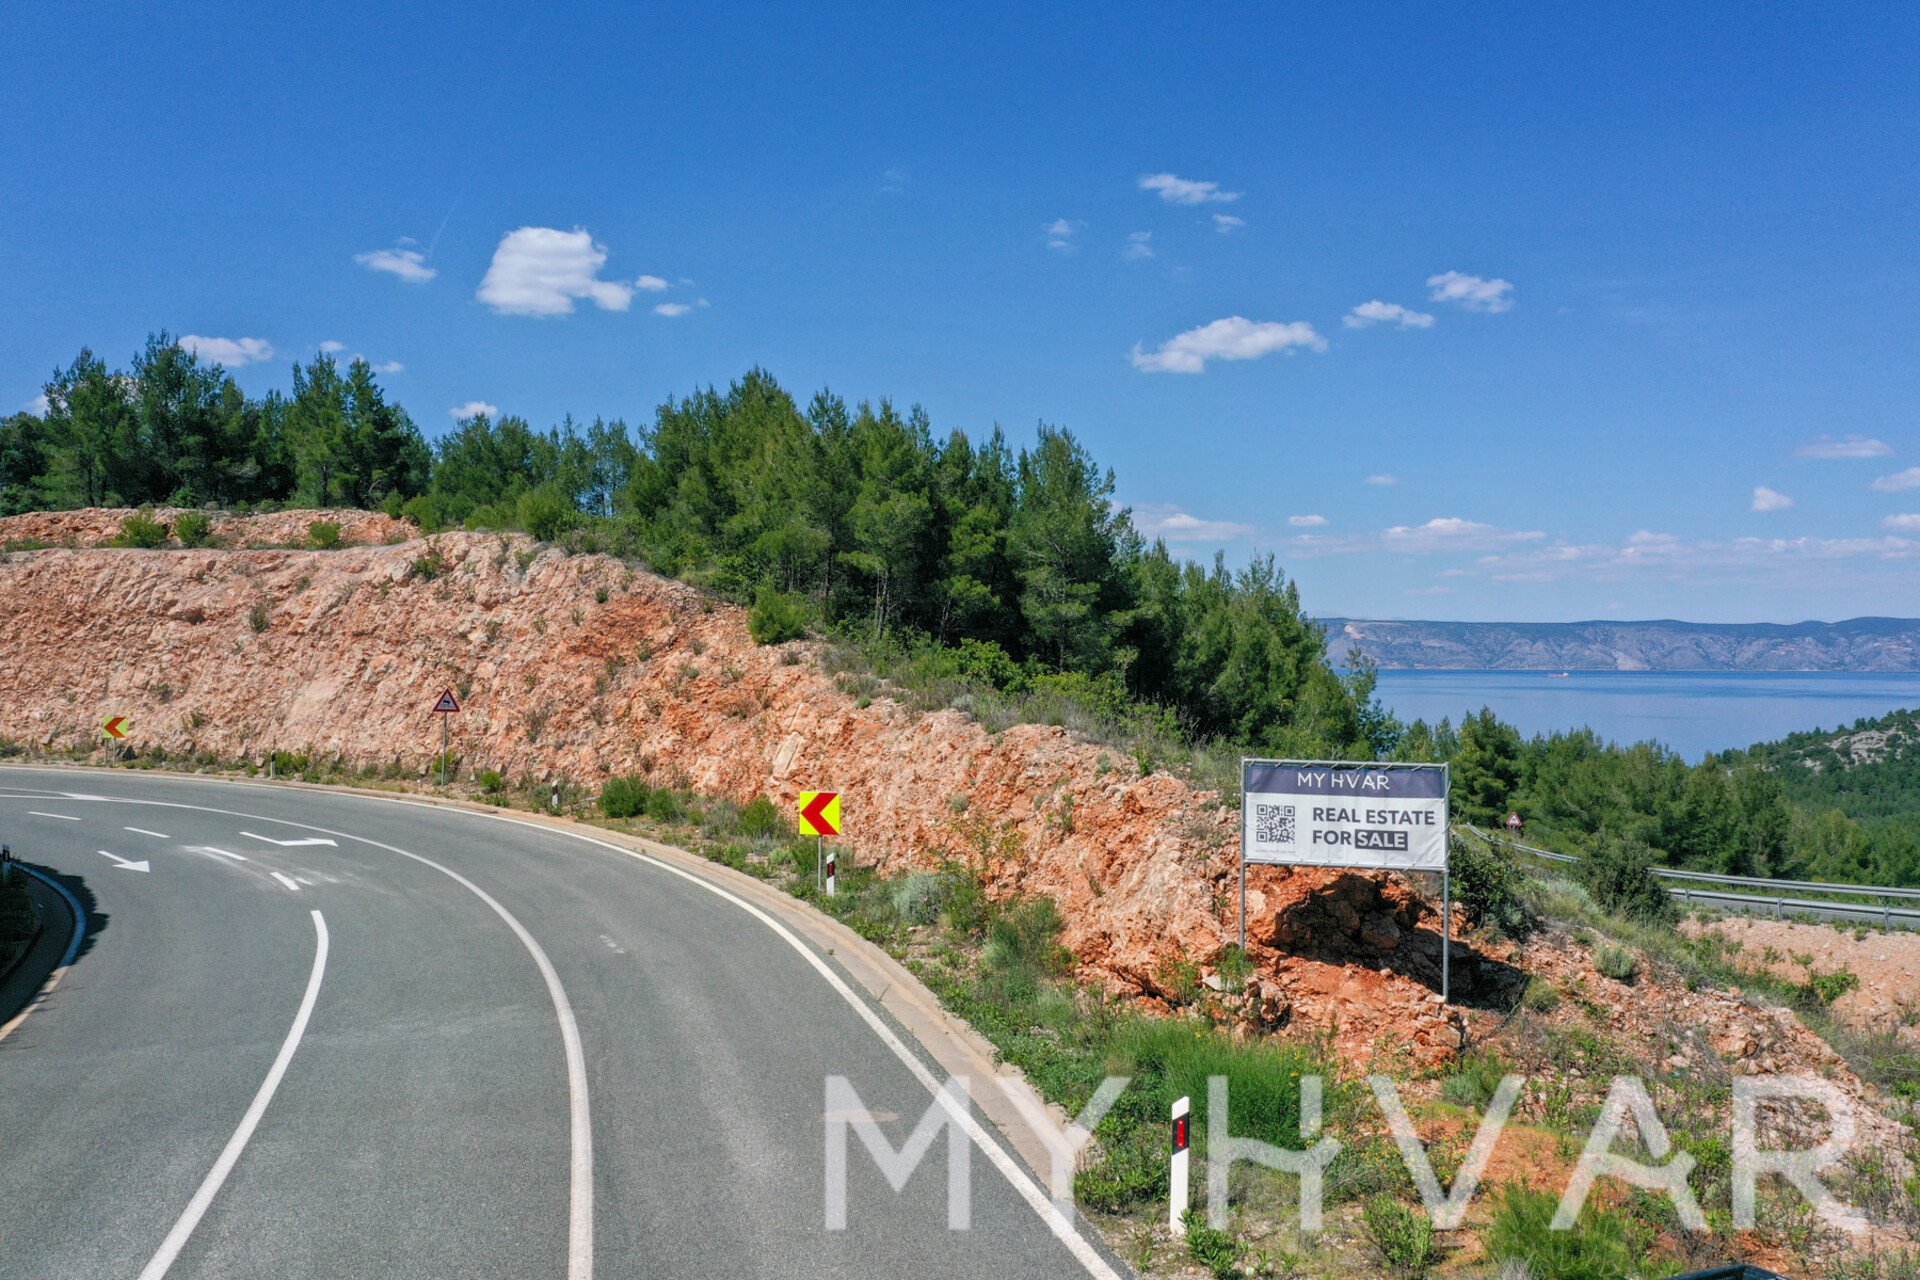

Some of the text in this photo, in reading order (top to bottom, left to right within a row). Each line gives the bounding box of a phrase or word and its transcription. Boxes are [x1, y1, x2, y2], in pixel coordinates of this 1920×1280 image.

[1297, 772, 1390, 790] MY HVAR
[1312, 807, 1435, 825] REAL ESTATE
[1312, 830, 1406, 848] FOR SALE
